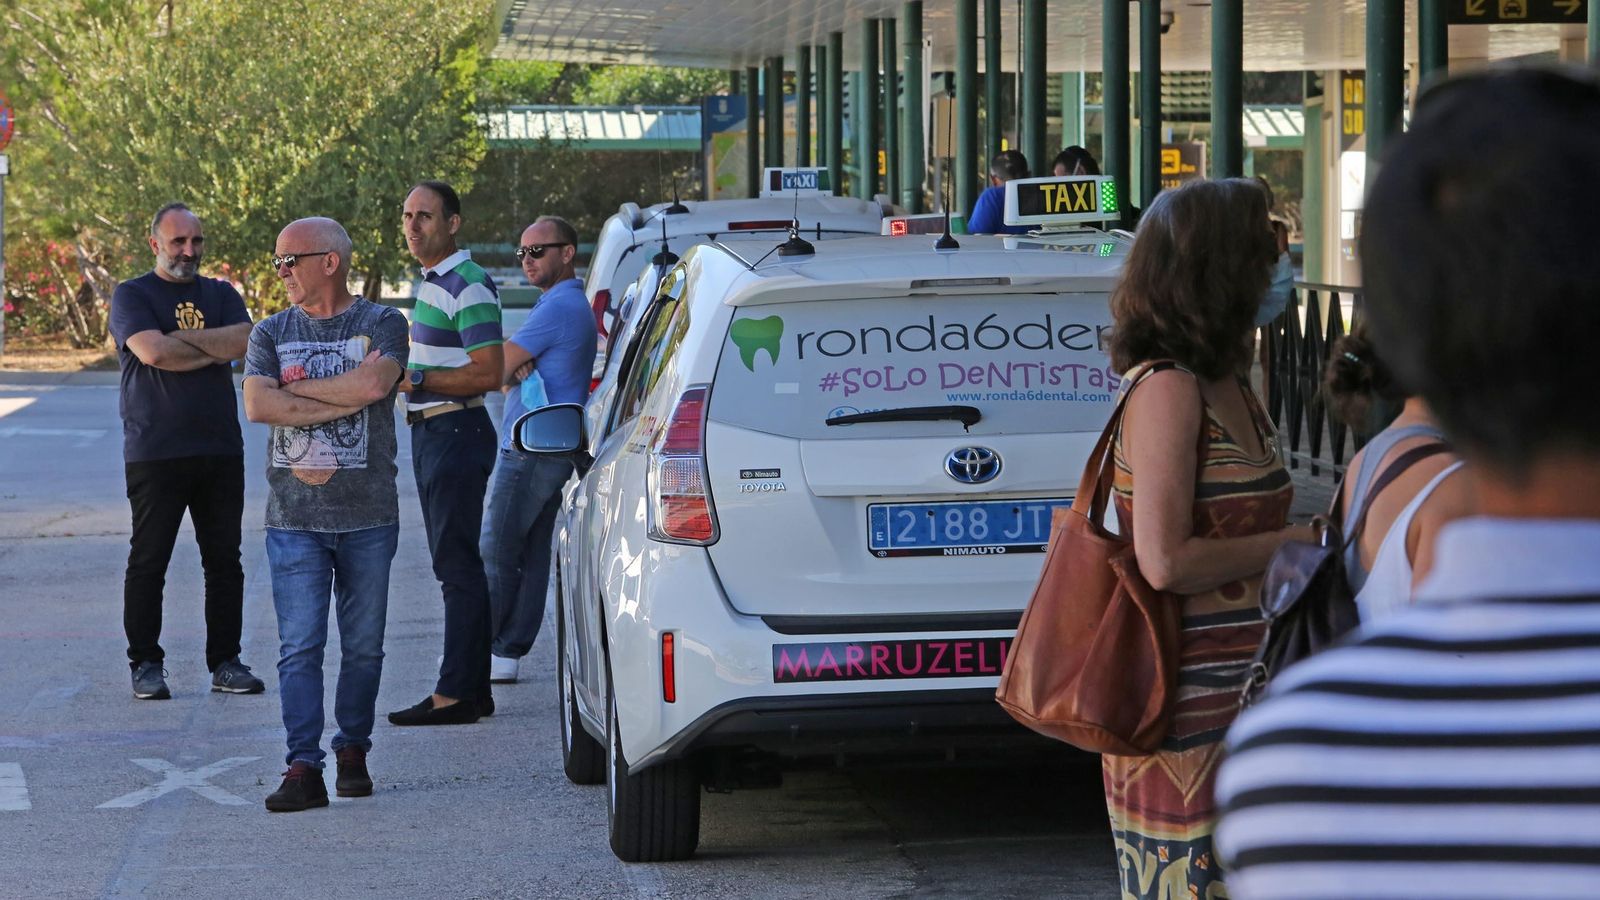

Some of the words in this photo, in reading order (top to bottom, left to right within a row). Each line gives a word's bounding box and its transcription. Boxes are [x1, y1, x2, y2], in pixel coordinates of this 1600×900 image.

[785, 173, 815, 188] TAXI
[1040, 182, 1096, 213] TAXI
[947, 390, 1111, 402] www.ronda6dental.com
[738, 482, 786, 493] TOYOTA
[876, 531, 884, 541] E
[897, 508, 989, 543] 2188
[1003, 505, 1070, 540] JT
[943, 546, 1005, 555] NIMAUTO
